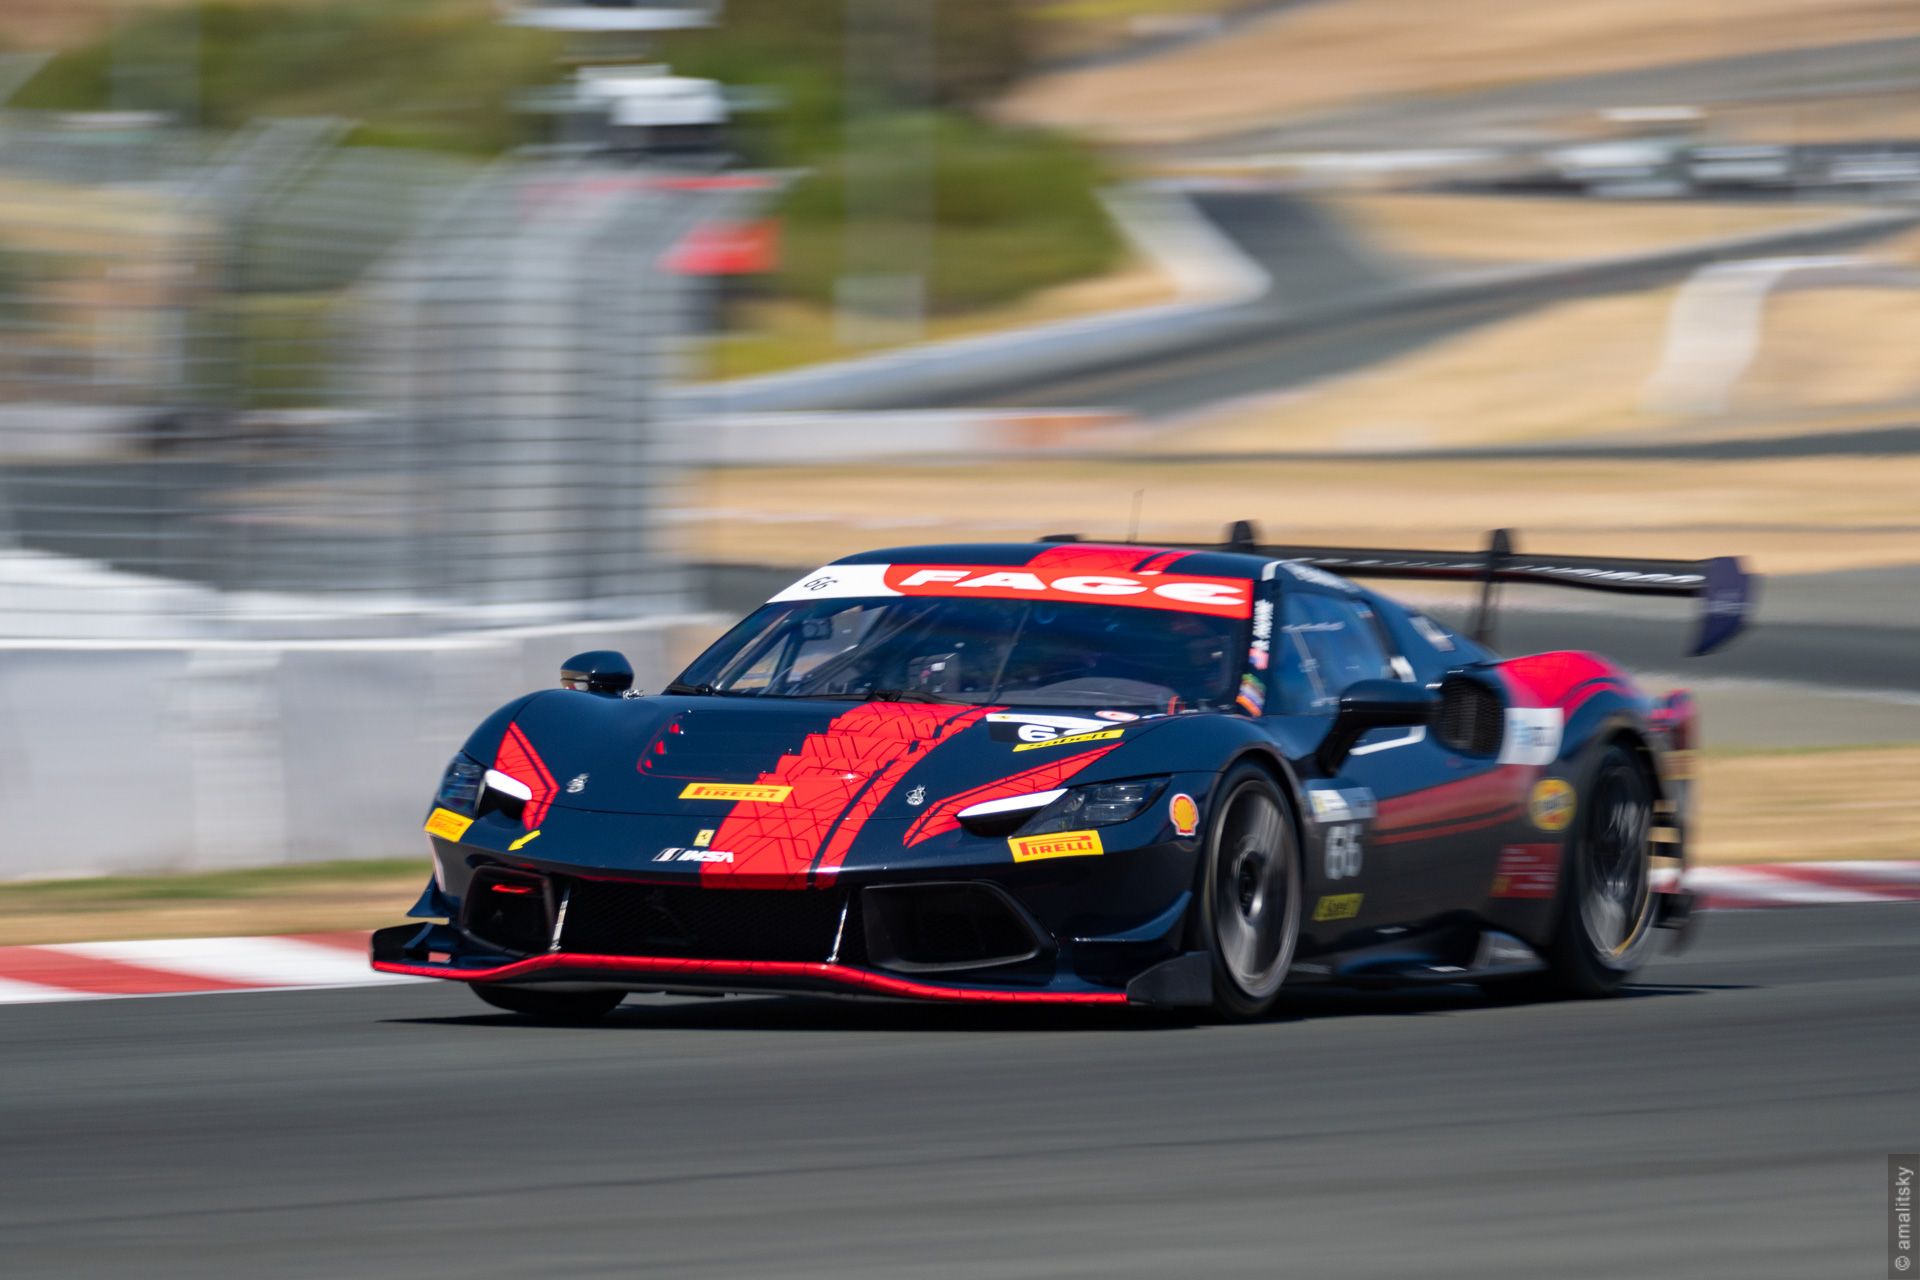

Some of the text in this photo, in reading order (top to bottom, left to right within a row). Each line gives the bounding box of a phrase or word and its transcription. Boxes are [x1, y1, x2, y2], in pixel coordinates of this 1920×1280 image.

[804, 576, 837, 591] 66
[693, 786, 780, 798] PIRELLI
[1019, 835, 1093, 857] PIRELLI
[676, 850, 734, 863] IMSA
